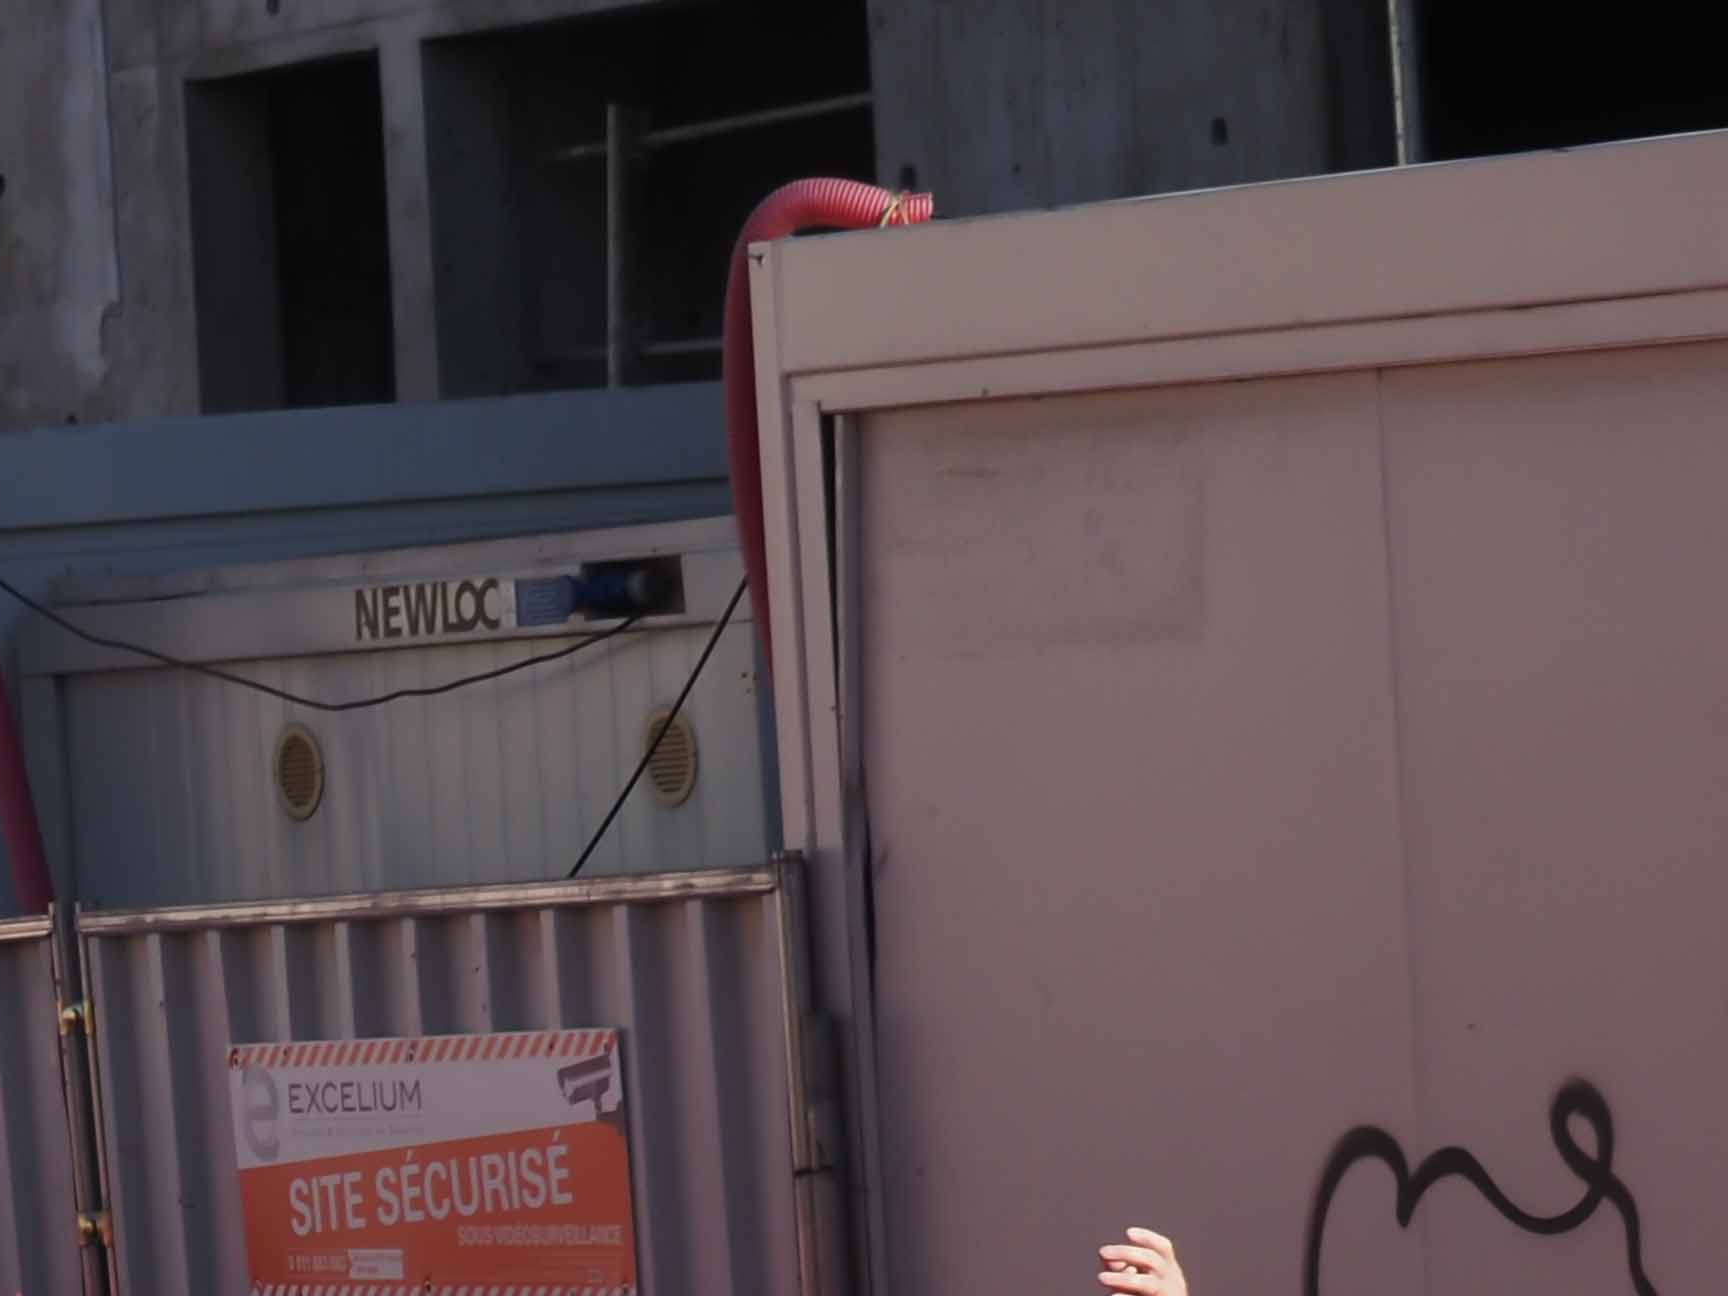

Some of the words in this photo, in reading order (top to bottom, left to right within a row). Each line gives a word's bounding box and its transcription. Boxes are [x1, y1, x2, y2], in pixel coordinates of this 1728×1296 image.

[354, 578, 500, 641] NEWLOC
[288, 1080, 423, 1113] EXCELIUM
[289, 1171, 367, 1237] SITE
[376, 1130, 573, 1227] SÉCURISÉ
